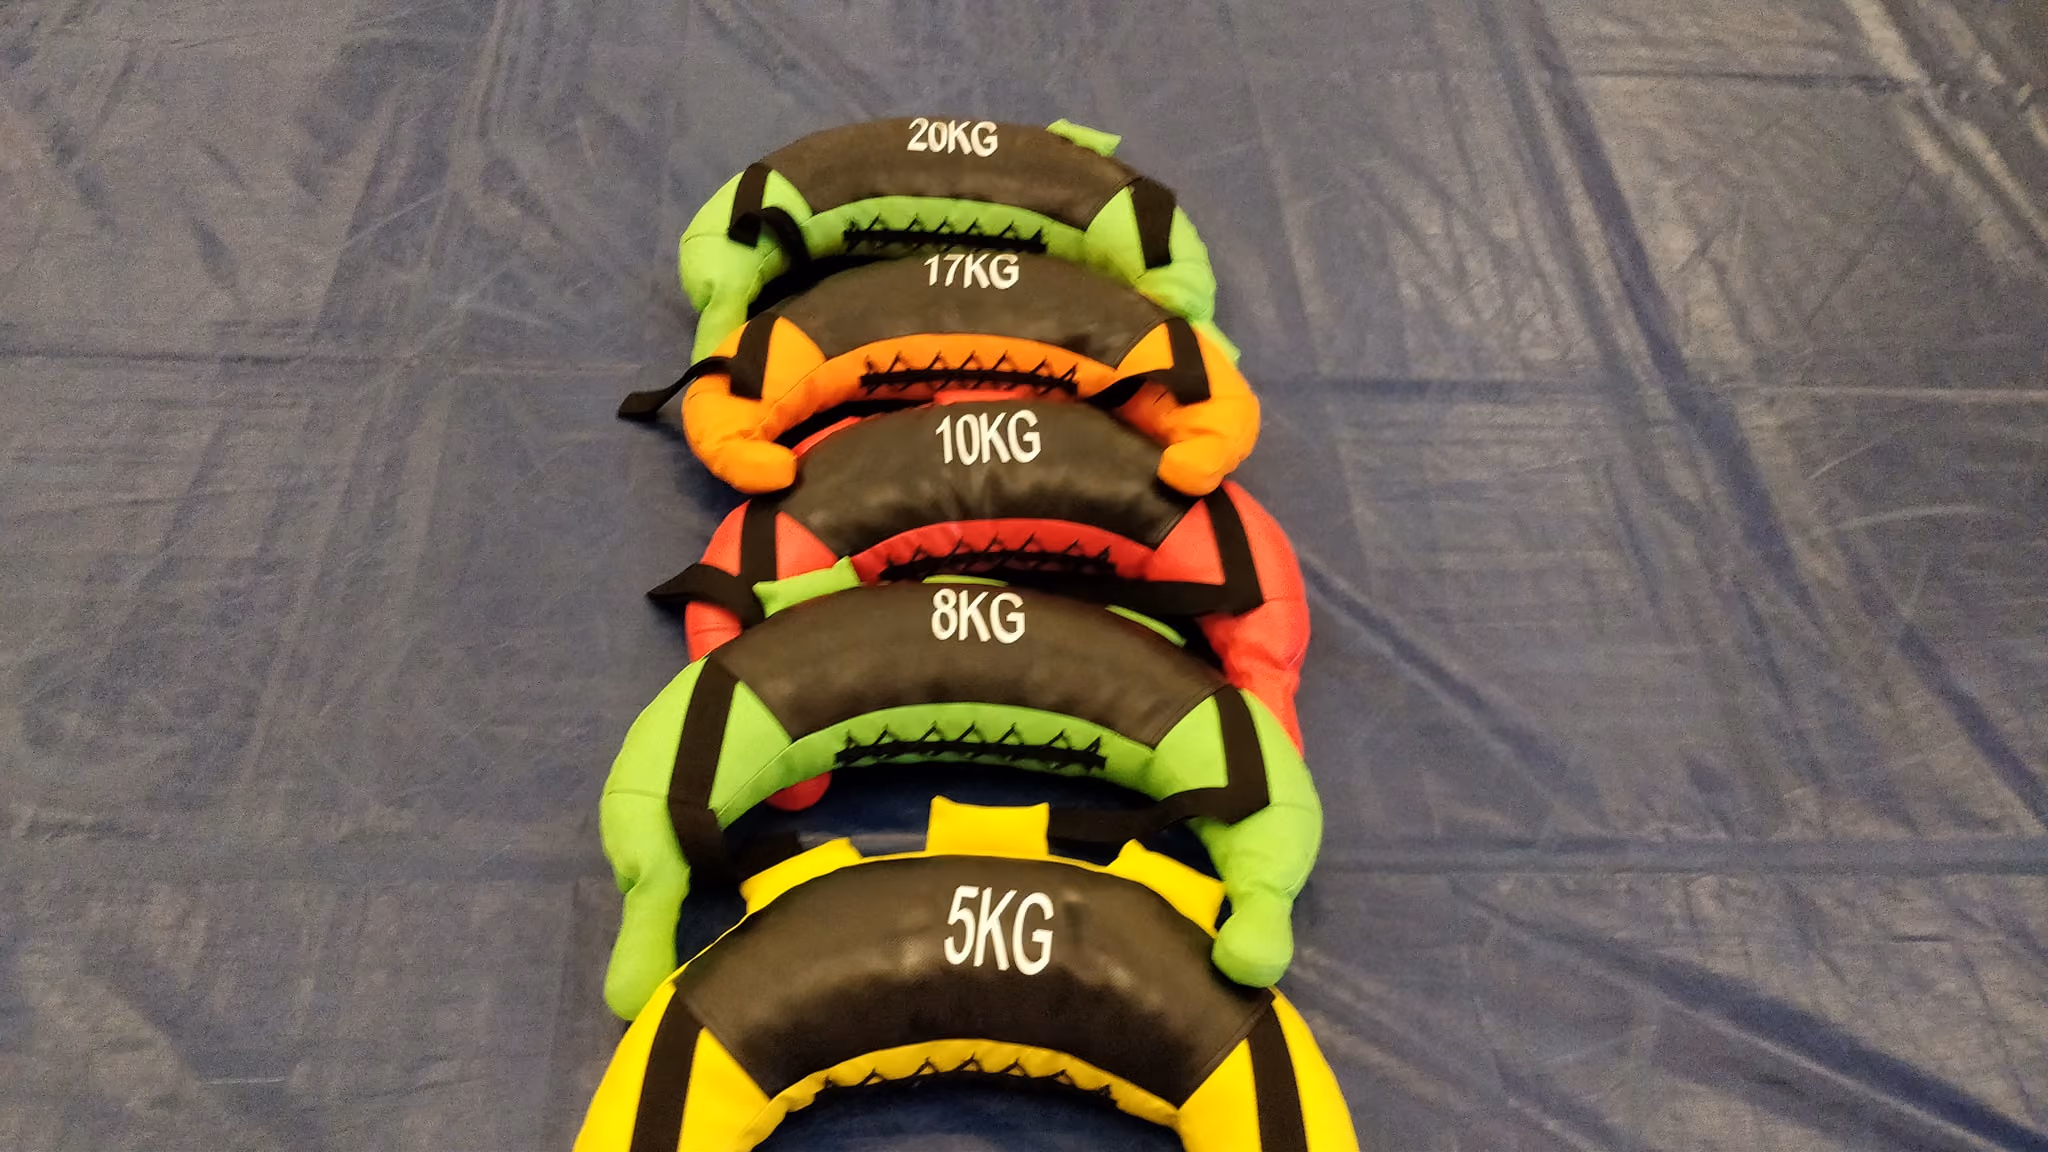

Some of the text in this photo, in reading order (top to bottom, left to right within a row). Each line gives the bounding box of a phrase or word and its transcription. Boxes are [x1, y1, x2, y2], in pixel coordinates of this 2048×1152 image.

[907, 117, 999, 158] 20KG
[923, 253, 1020, 290] 17KG
[935, 409, 1042, 466] 10KG
[931, 588, 1026, 644] 8KG
[943, 885, 1054, 976] 5KG
